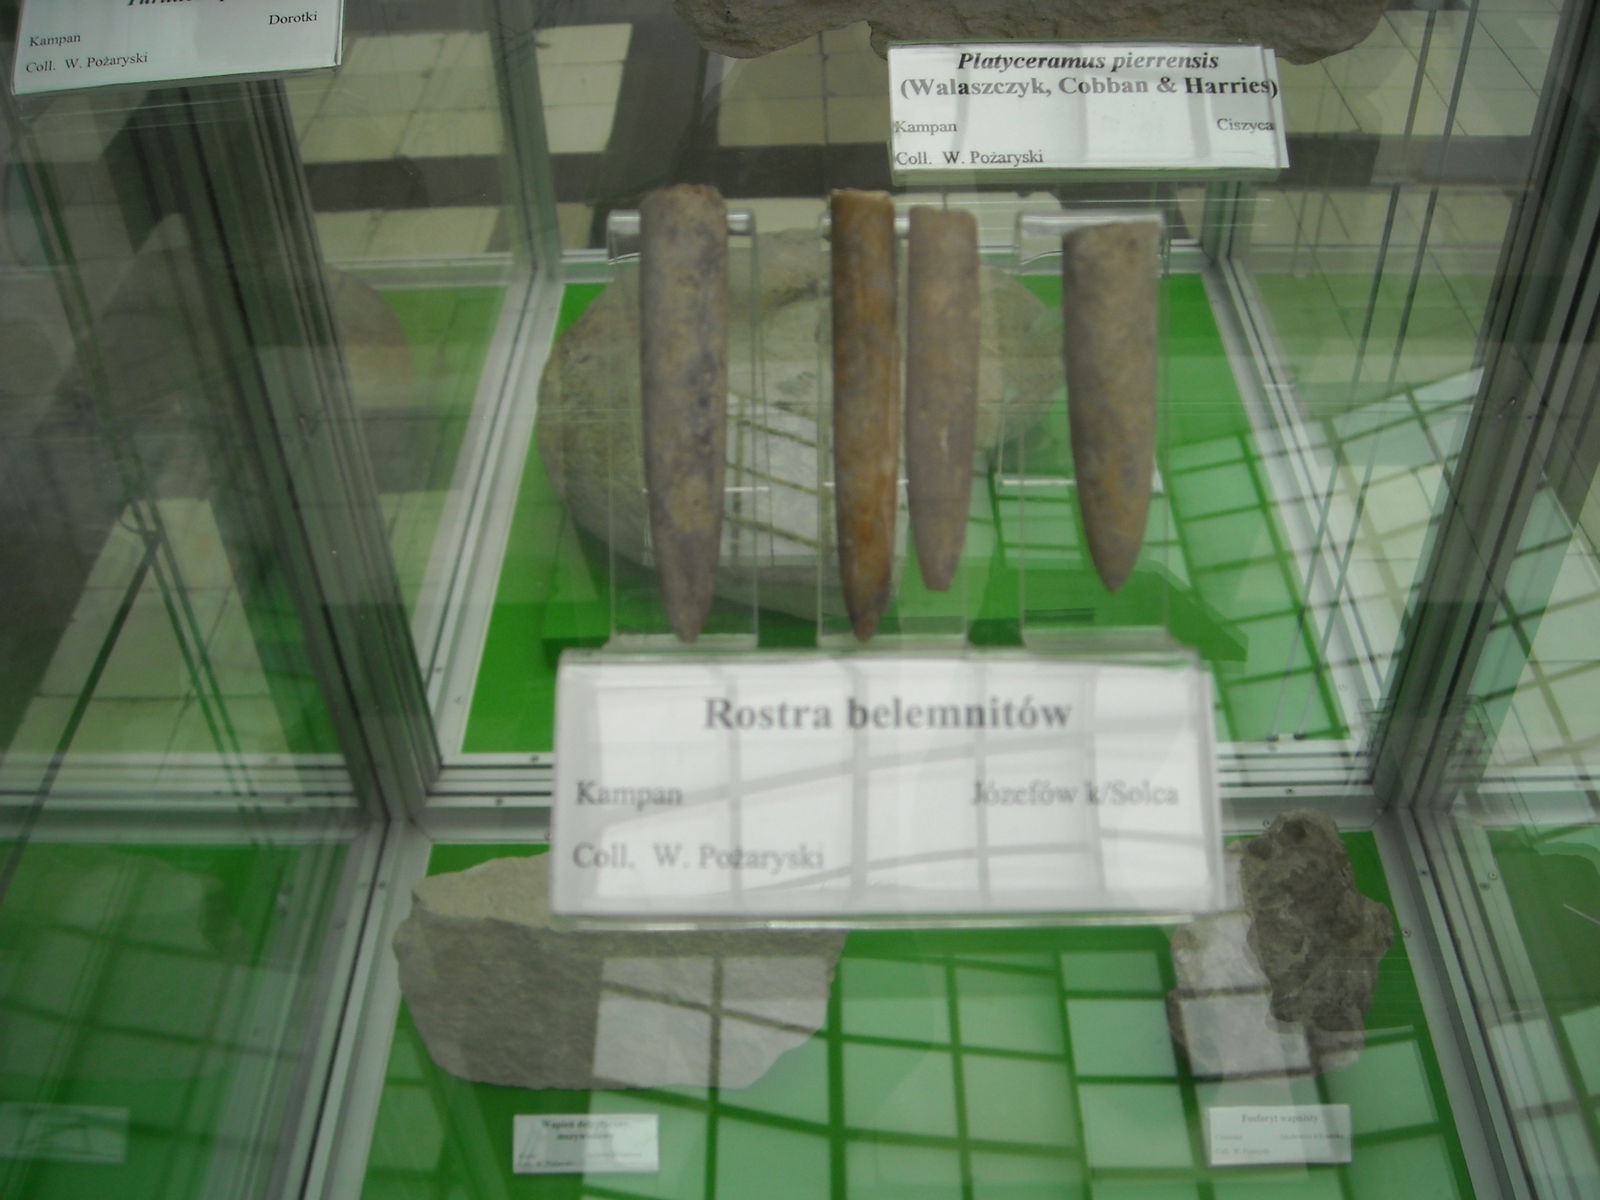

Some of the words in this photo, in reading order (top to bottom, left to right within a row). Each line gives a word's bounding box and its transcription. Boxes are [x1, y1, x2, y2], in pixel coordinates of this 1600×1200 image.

[268, 11, 318, 25] Dorotki
[29, 34, 81, 47] Kampan
[26, 61, 56, 73] Coll.
[65, 58, 82, 69] W.
[87, 53, 148, 69] Pożaryski
[958, 53, 1106, 71] Platyceramus
[1112, 52, 1219, 71] pierrensis
[900, 78, 1052, 99] (Walaszczyk,
[1058, 77, 1148, 95] Cobban
[1156, 76, 1177, 94] &
[1185, 77, 1279, 98] Harries)
[894, 121, 958, 135] Kampan
[1216, 118, 1274, 133] Ciszyca
[895, 151, 933, 166] Coll.
[942, 151, 964, 165] W.
[970, 150, 1044, 167] Pożaryski
[705, 698, 832, 728] Rostra
[847, 695, 1073, 729] belemnitów
[575, 780, 683, 811] Kampan
[972, 780, 1080, 806] Józefów
[573, 844, 635, 869] Coll.
[652, 844, 690, 869] W.
[697, 843, 825, 874] Pożaryski
